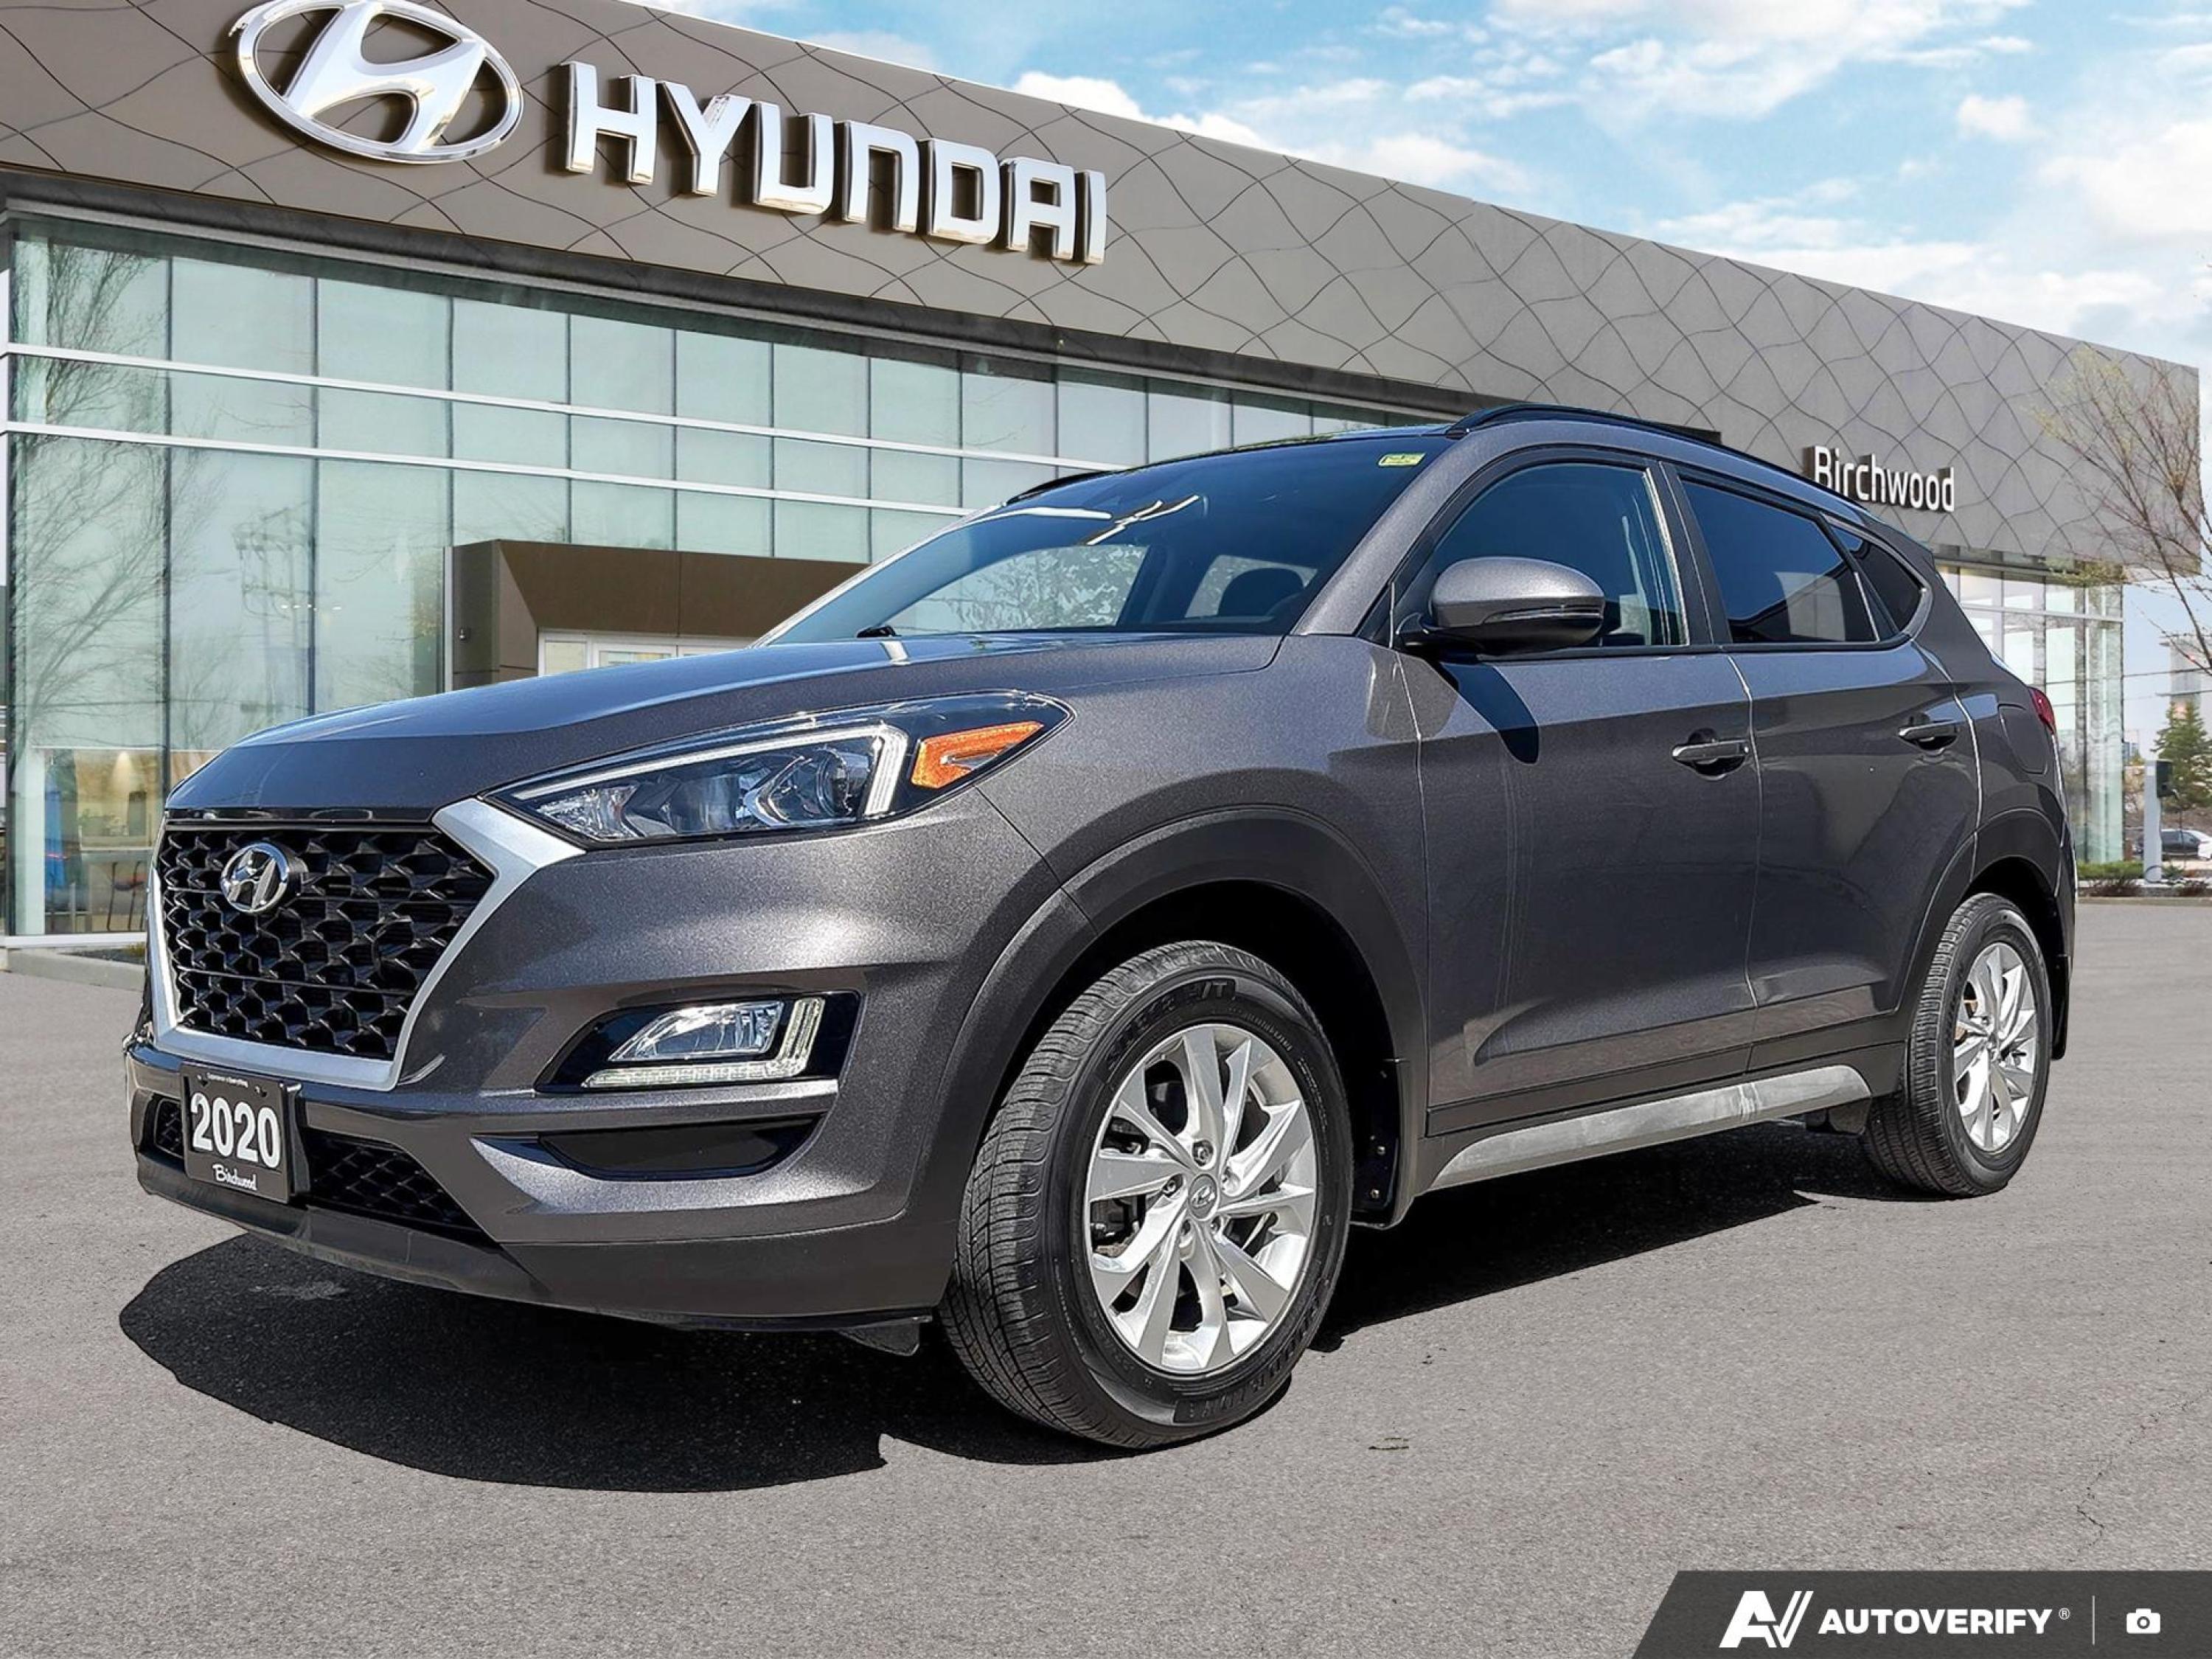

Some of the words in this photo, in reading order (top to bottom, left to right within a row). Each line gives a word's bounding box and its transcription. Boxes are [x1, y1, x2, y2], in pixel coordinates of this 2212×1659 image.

[560, 61, 1107, 265] HYUNDAI
[1812, 445, 1955, 512] Birchwood
[190, 1093, 281, 1168] 2020
